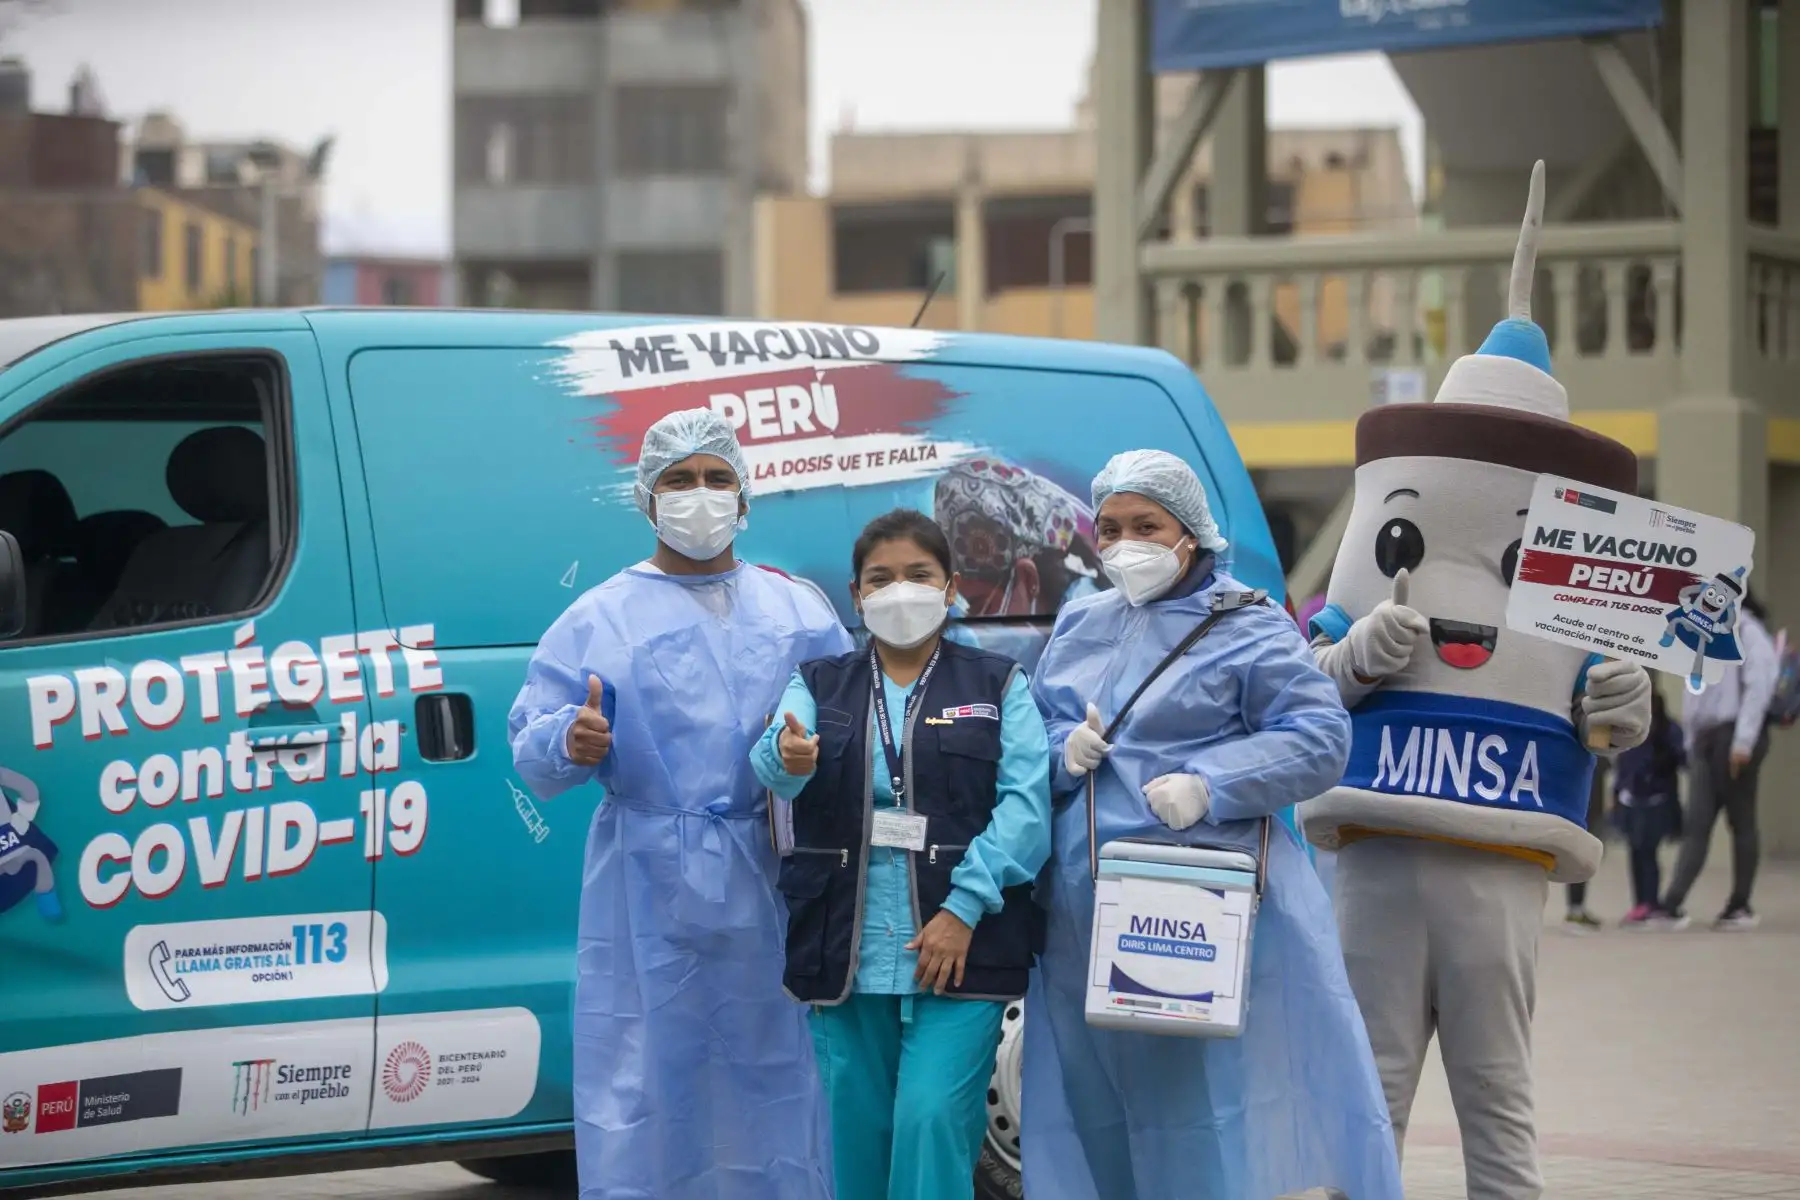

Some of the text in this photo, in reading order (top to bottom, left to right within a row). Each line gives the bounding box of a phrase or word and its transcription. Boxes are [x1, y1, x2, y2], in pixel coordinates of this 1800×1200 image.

[609, 327, 880, 378] ME VACUNO
[709, 371, 840, 439] PERÚ
[755, 444, 938, 480] LA DOSIS UE TE FALTA
[1666, 515, 1697, 528] Siempre
[1533, 526, 1697, 567] ME VACUNO
[1568, 563, 1655, 596] PERÚ
[1553, 593, 1665, 616] COMPLETA TUS DOSIS
[1553, 614, 1645, 645] Acude al centro de
[1687, 612, 1713, 632] MINSA
[1535, 620, 1659, 660] vacunación más cercano
[26, 620, 443, 750] PROTÉGETE
[100, 711, 400, 814] contra la
[1371, 725, 1544, 808] MINSA
[0, 831, 20, 852] SA
[79, 781, 428, 909] COVID-19
[1130, 915, 1207, 942] MINSA
[175, 922, 348, 974] LLAMA GRATIS AL 113
[175, 939, 292, 958] PARA MÁS INFORMACIÓN
[1120, 939, 1214, 958] DIRIS LIMA CENTRO
[252, 969, 294, 983] OPCIÓN 1
[439, 1050, 507, 1063] BICENTENARIO
[276, 1064, 352, 1085] Siempre
[437, 1062, 482, 1075] DEL PERÚ
[437, 1077, 454, 1086] 2021
[84, 1092, 131, 1107] Ministerio
[275, 1082, 350, 1105] con el pueblo
[41, 1096, 74, 1116] PERÚ
[83, 1104, 122, 1119] de Salud
